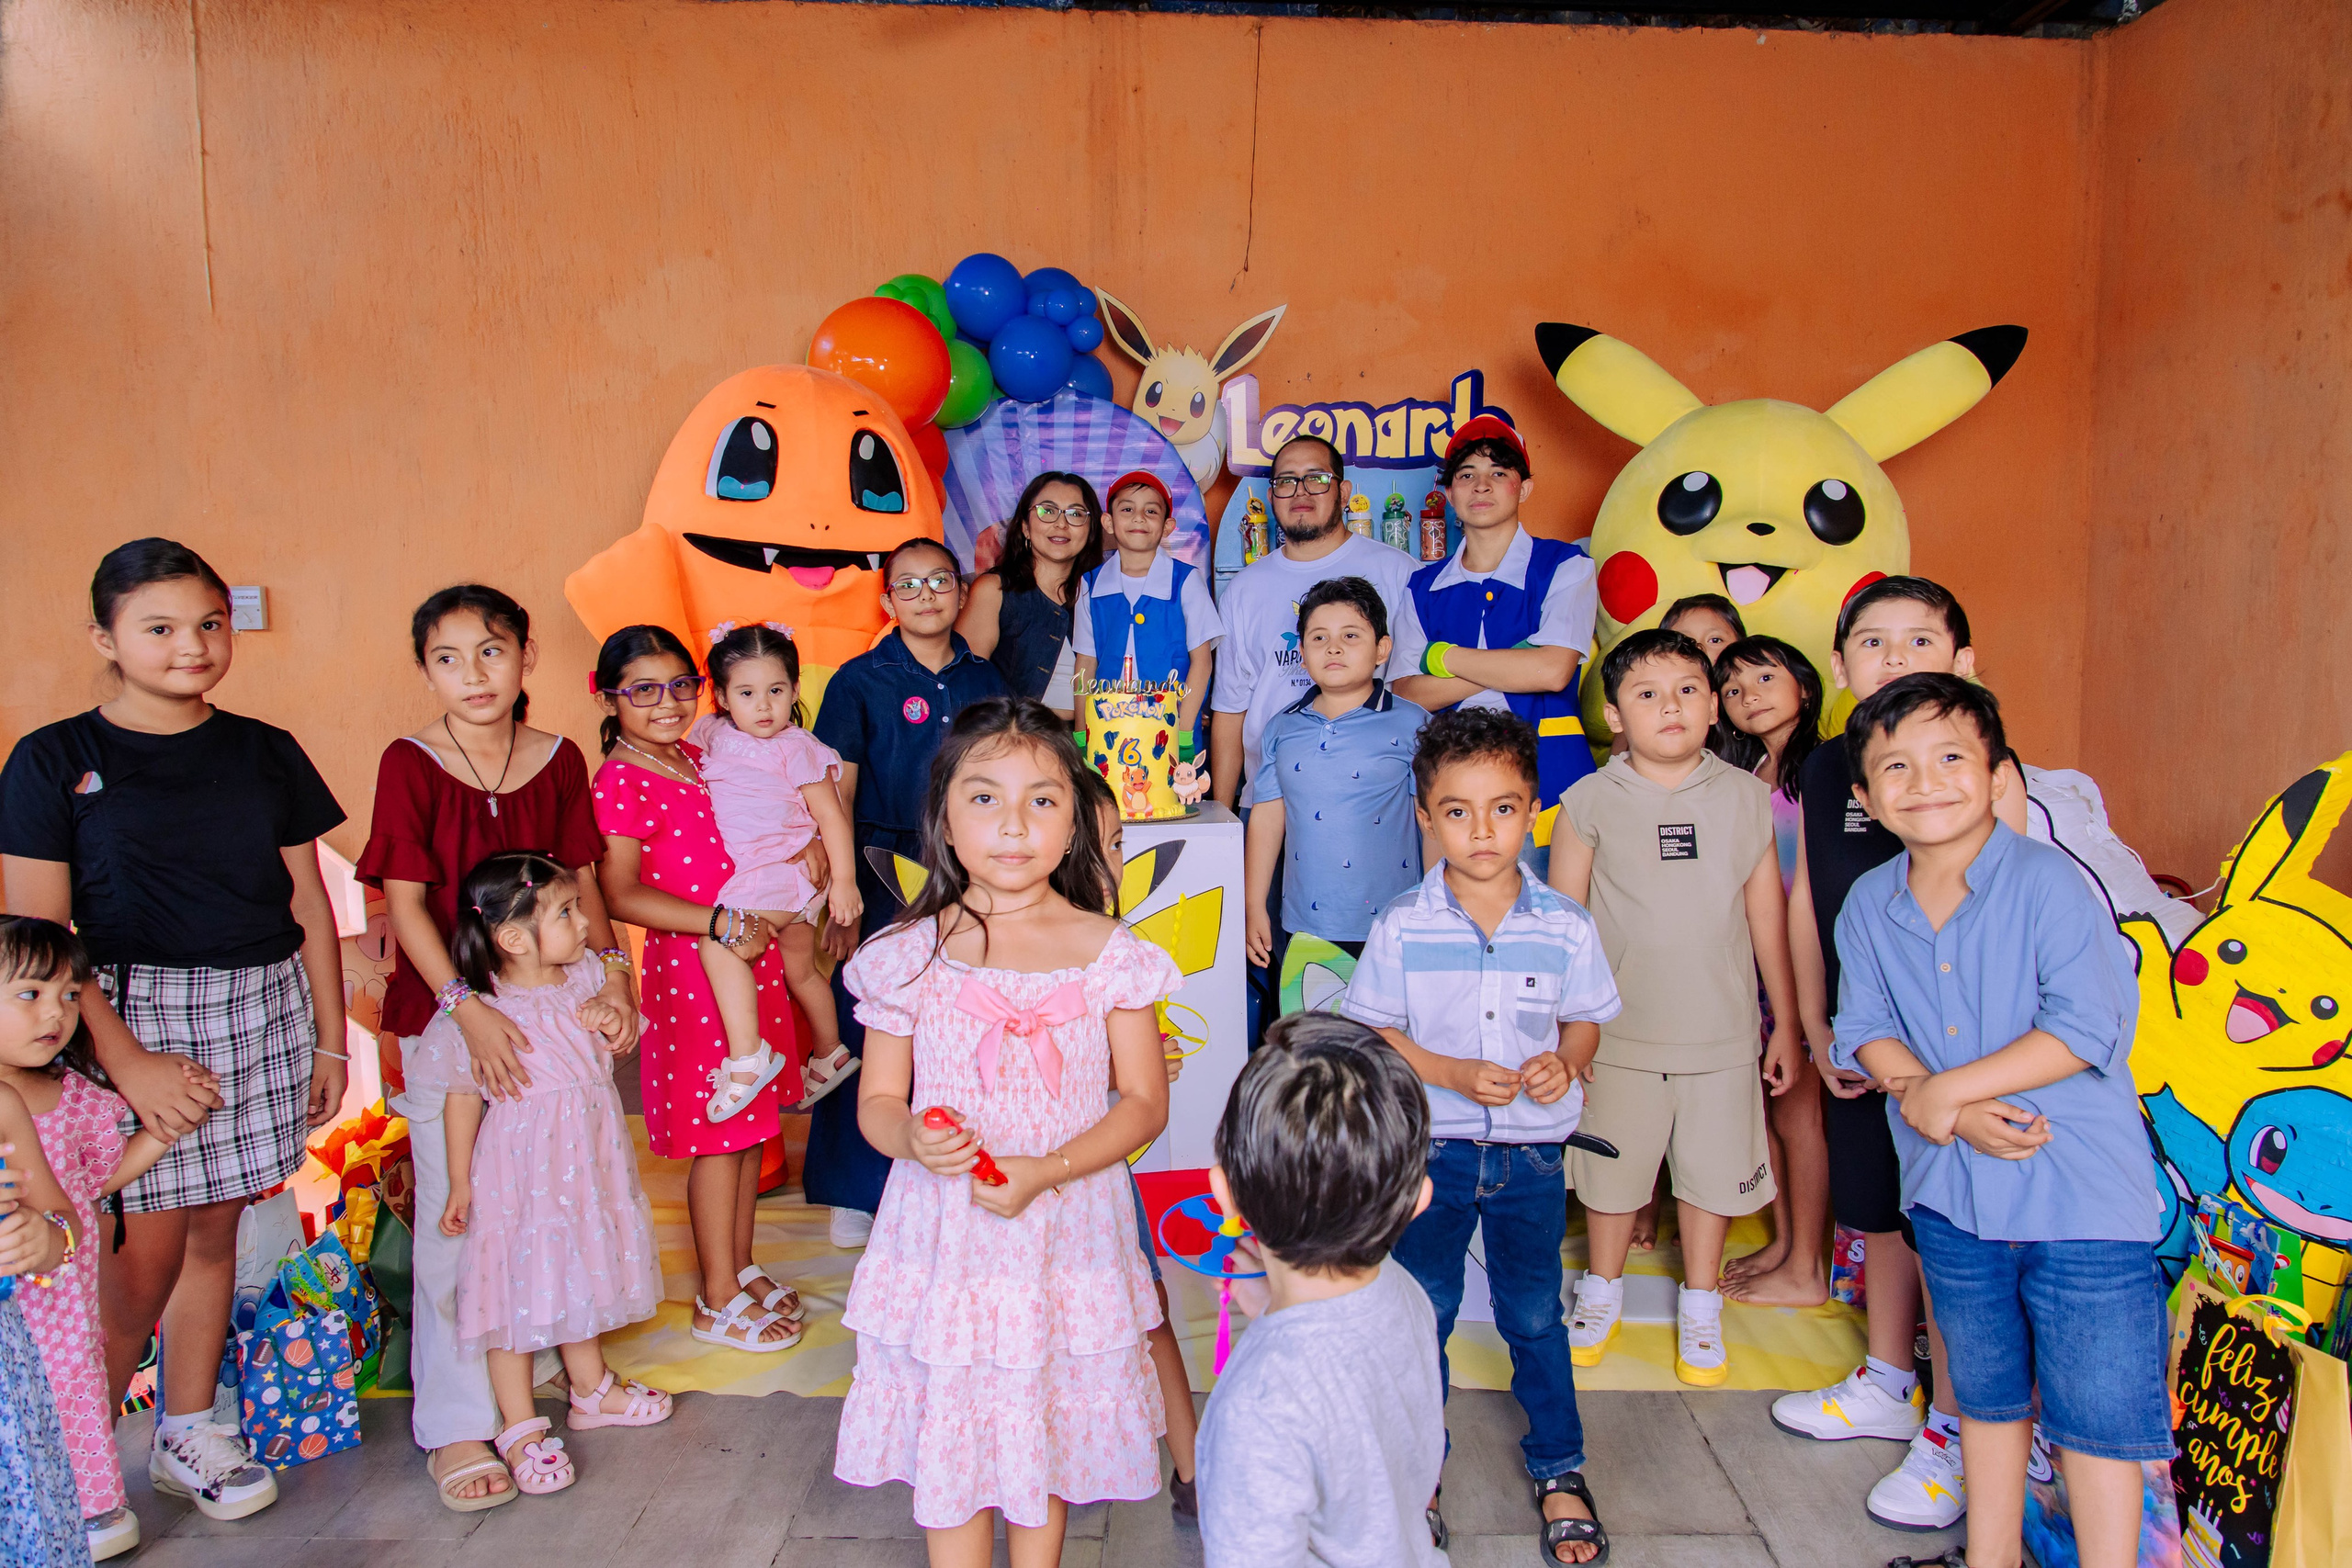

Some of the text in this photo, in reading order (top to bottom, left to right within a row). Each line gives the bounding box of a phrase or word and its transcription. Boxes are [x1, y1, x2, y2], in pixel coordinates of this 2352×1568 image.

[1224, 372, 1501, 470] Leonard
[1070, 668, 1192, 699] Leonardo
[1122, 738, 1142, 766] 6
[1659, 826, 1692, 836] DISTRICT
[1739, 1162, 1768, 1194] DISTRICT
[2201, 1323, 2278, 1423] feliz
[2180, 1381, 2278, 1479] cumple
[2188, 1437, 2254, 1514] años
